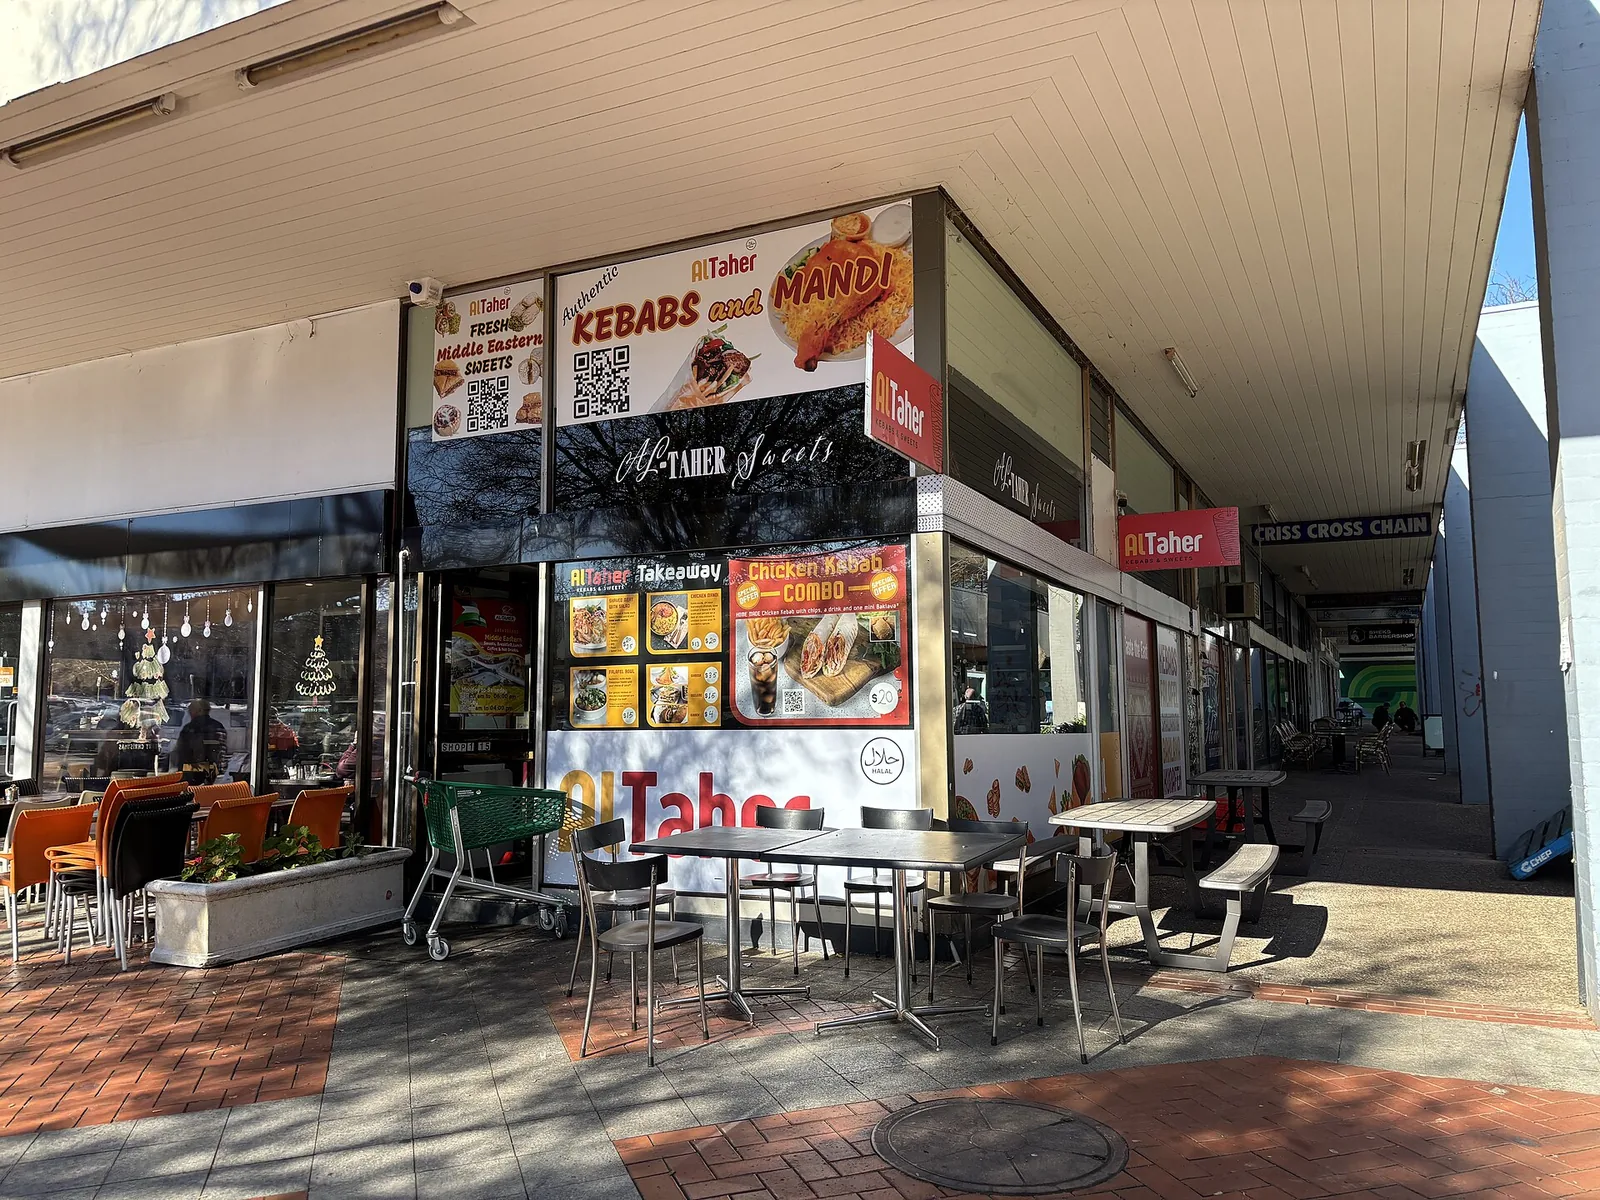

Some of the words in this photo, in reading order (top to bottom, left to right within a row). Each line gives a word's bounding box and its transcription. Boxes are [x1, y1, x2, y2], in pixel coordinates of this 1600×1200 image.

[692, 253, 757, 282] AlTaher
[470, 297, 510, 316] AlTaher
[563, 266, 619, 326] Authentic
[572, 289, 702, 346] KEBABS
[708, 288, 763, 322] and
[774, 252, 894, 310] MANDI
[470, 318, 509, 337] FRESH
[437, 341, 484, 362] Middle
[488, 333, 543, 354] Eastern
[465, 355, 513, 375] SWEETS
[876, 371, 924, 438] AlTaher
[876, 417, 894, 435] KEBABS
[901, 433, 918, 449] SWEETS
[732, 434, 834, 490] Sweets
[1030, 482, 1056, 521] Sweets
[1254, 525, 1301, 542] CRISS
[1307, 521, 1363, 538] CROSS
[1370, 517, 1428, 535] CHAIN
[1124, 530, 1203, 556] AlTaher
[570, 568, 633, 586] AlTaher
[638, 564, 722, 582] Takeaway
[748, 562, 818, 580] Chicken
[825, 554, 883, 575] Kebab
[738, 585, 758, 598] SPECIAL
[784, 580, 845, 602] COMBO
[872, 575, 895, 588] SPECIAL
[874, 582, 896, 596] OFFER
[739, 591, 759, 605] OFFER
[808, 607, 822, 615] chips,
[872, 689, 893, 704] $20
[864, 747, 900, 766] حلال
[1530, 849, 1552, 867] CHEP
